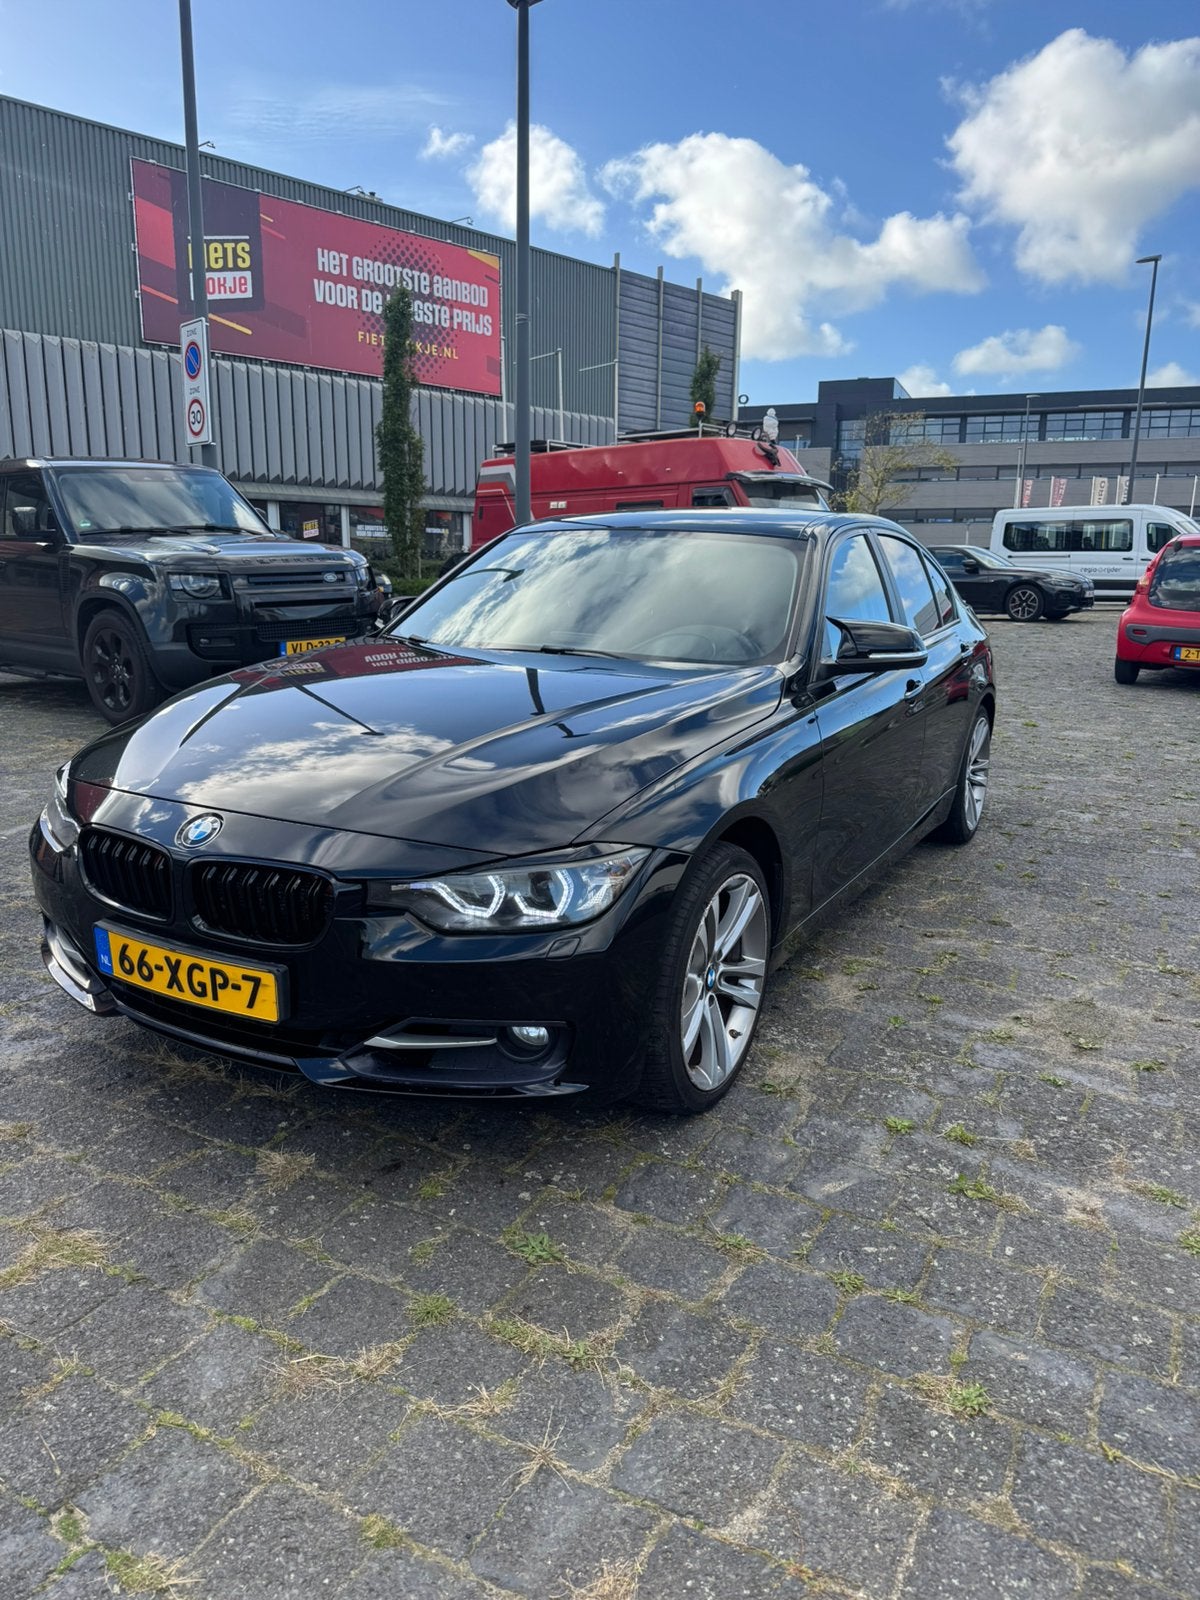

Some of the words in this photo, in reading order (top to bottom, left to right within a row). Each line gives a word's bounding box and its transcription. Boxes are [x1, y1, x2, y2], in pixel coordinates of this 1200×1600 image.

[313, 278, 358, 310] VOOR
[453, 308, 492, 336] PRIJS
[191, 410, 202, 425] 30
[118, 943, 262, 1009] 66-XGP-7
